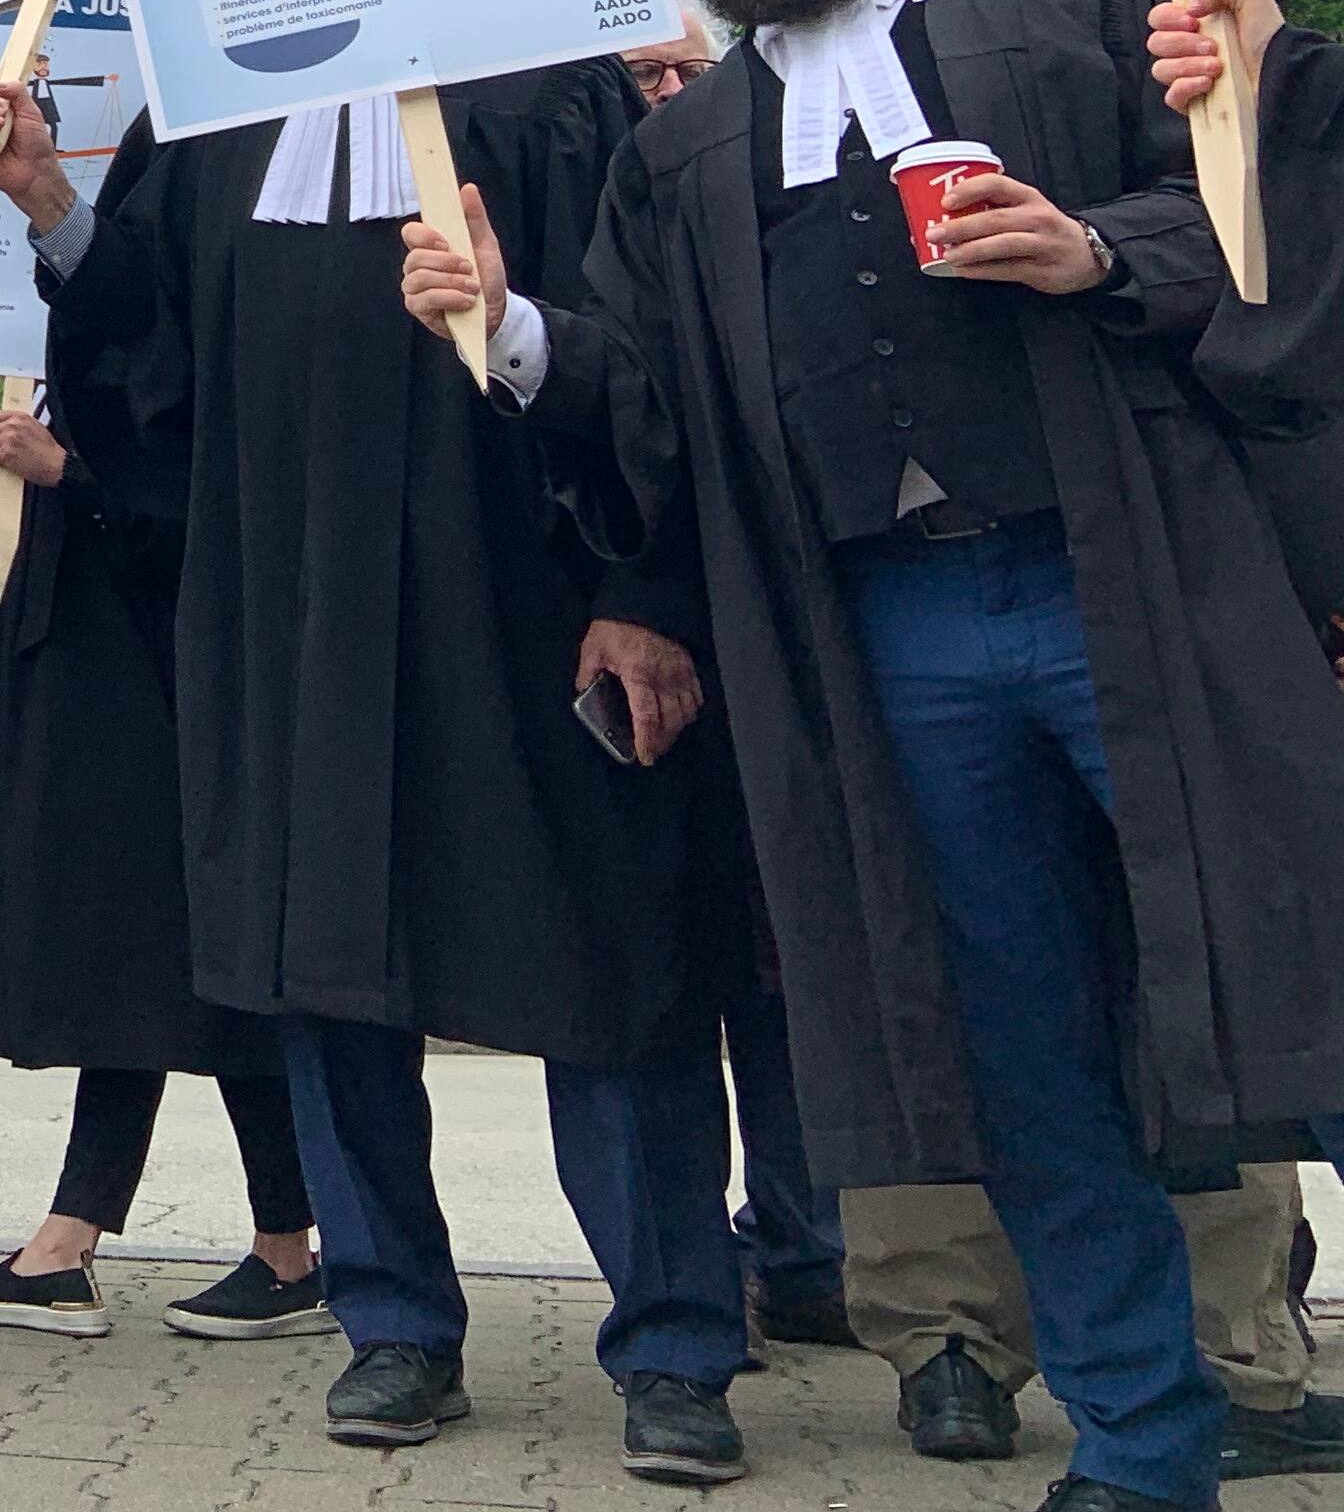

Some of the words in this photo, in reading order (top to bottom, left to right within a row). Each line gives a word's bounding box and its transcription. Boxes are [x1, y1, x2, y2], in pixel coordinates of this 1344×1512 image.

[223, 8, 271, 24] services
[599, 9, 651, 29] AADO
[226, 20, 283, 39] problème
[287, 15, 303, 24] de
